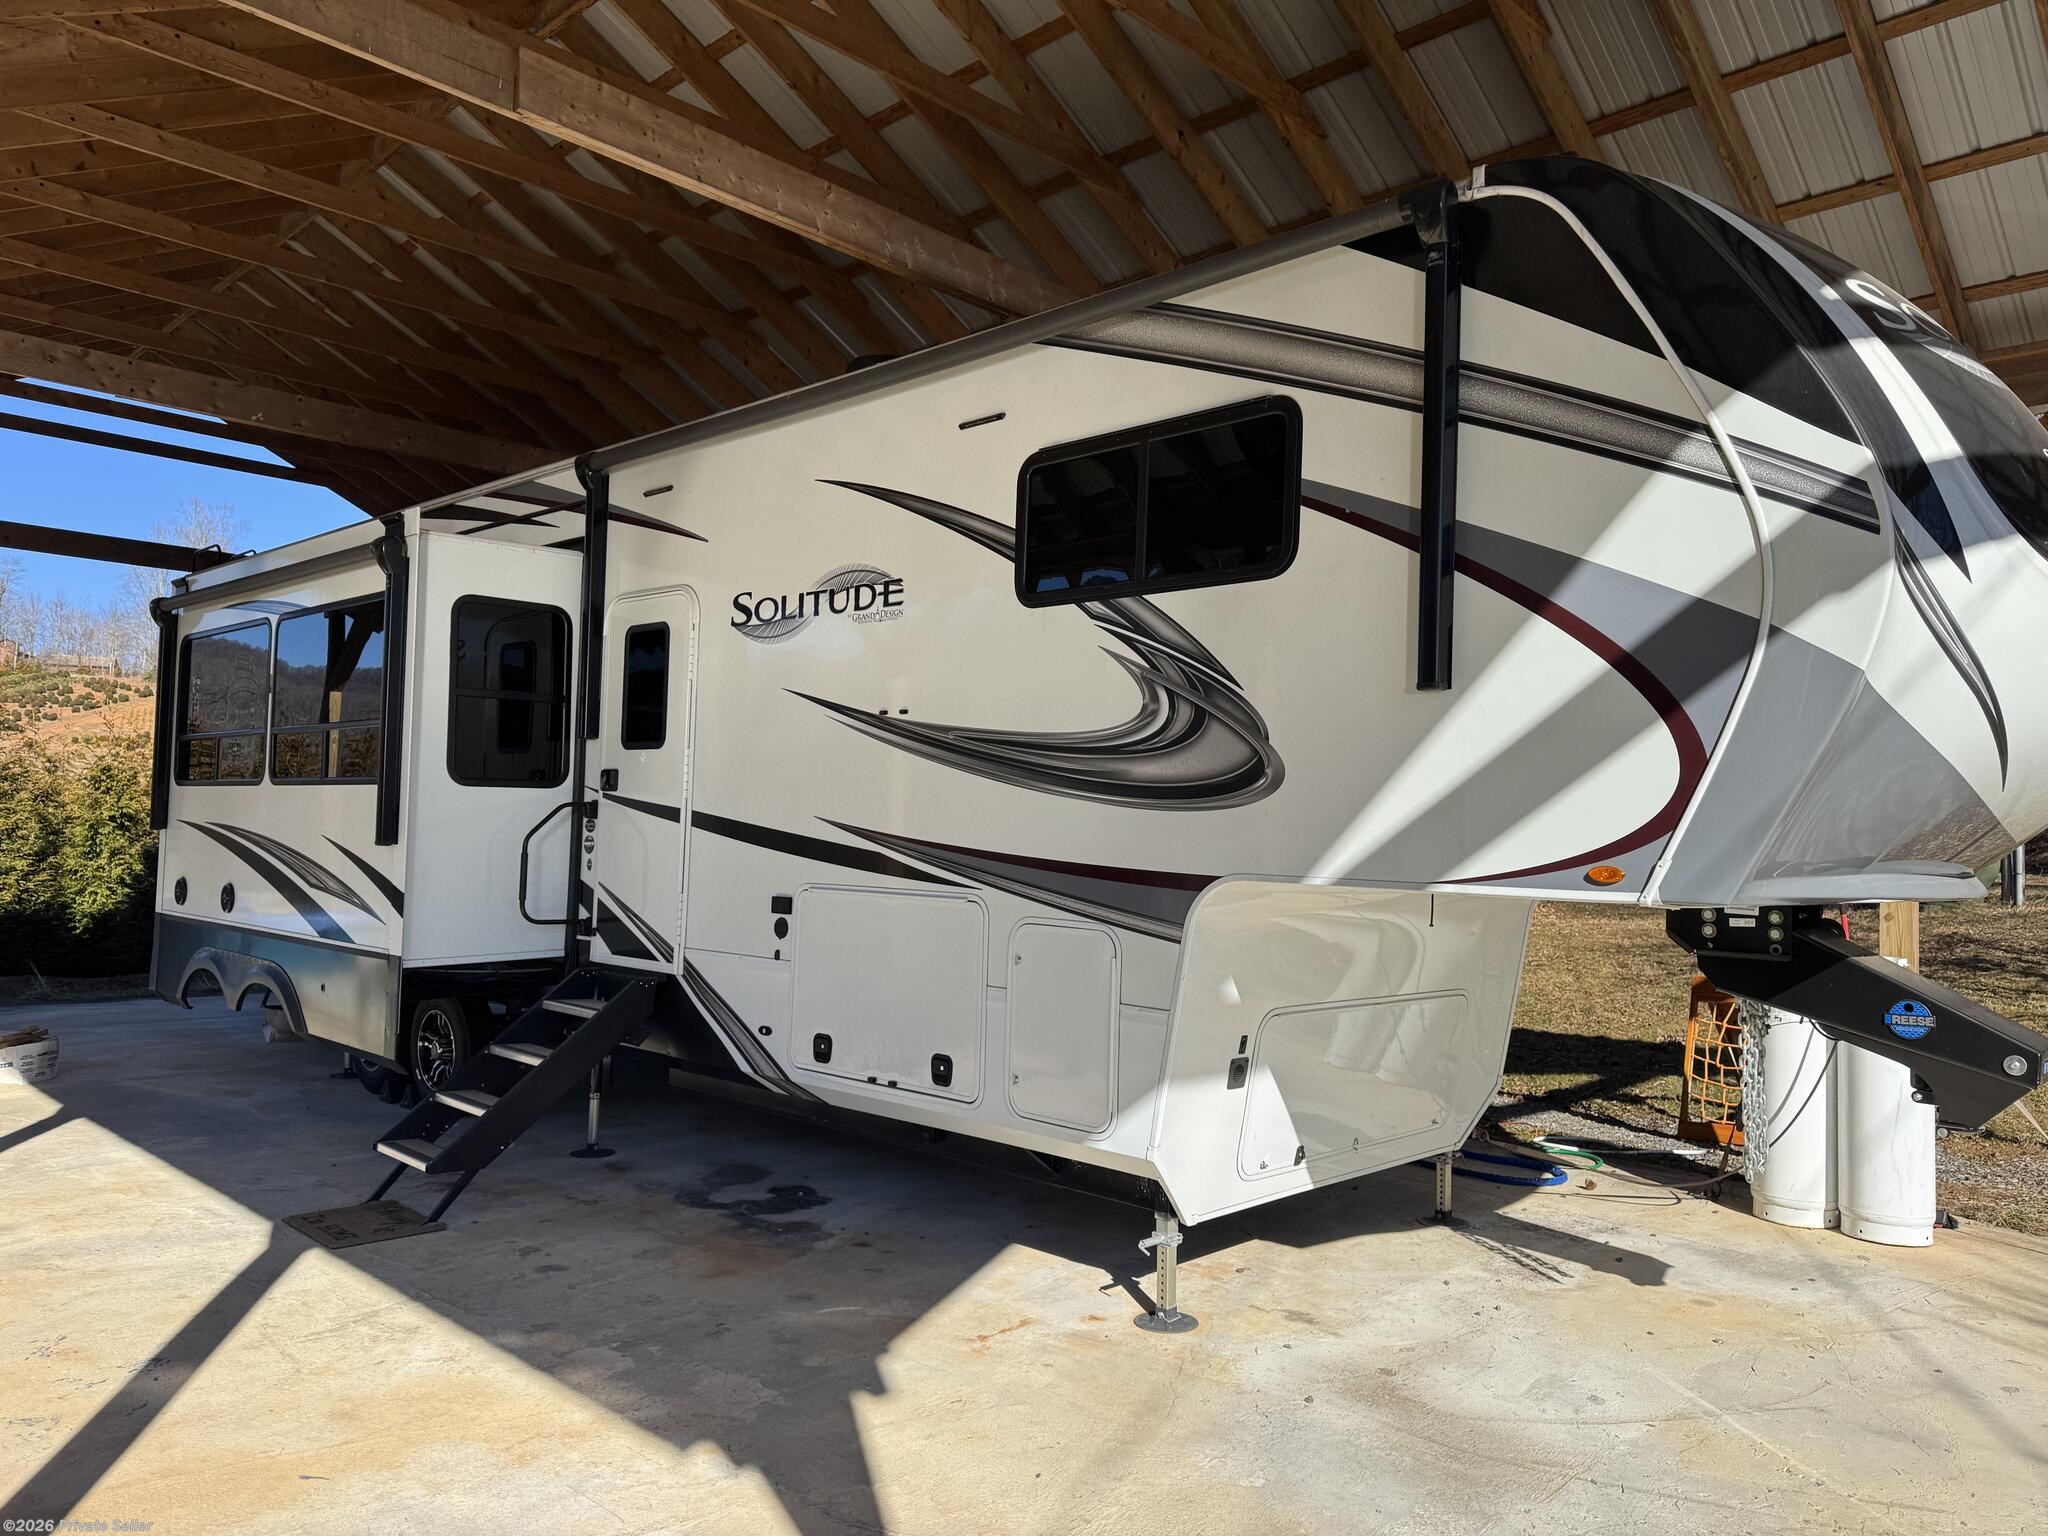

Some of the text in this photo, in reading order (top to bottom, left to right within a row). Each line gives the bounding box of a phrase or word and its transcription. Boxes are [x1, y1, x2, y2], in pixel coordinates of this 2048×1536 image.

[731, 577, 904, 627] SOLITUDE
[852, 611, 876, 622] GRAND
[880, 608, 904, 618] DESIGN
[1891, 1014, 1934, 1027] REESE
